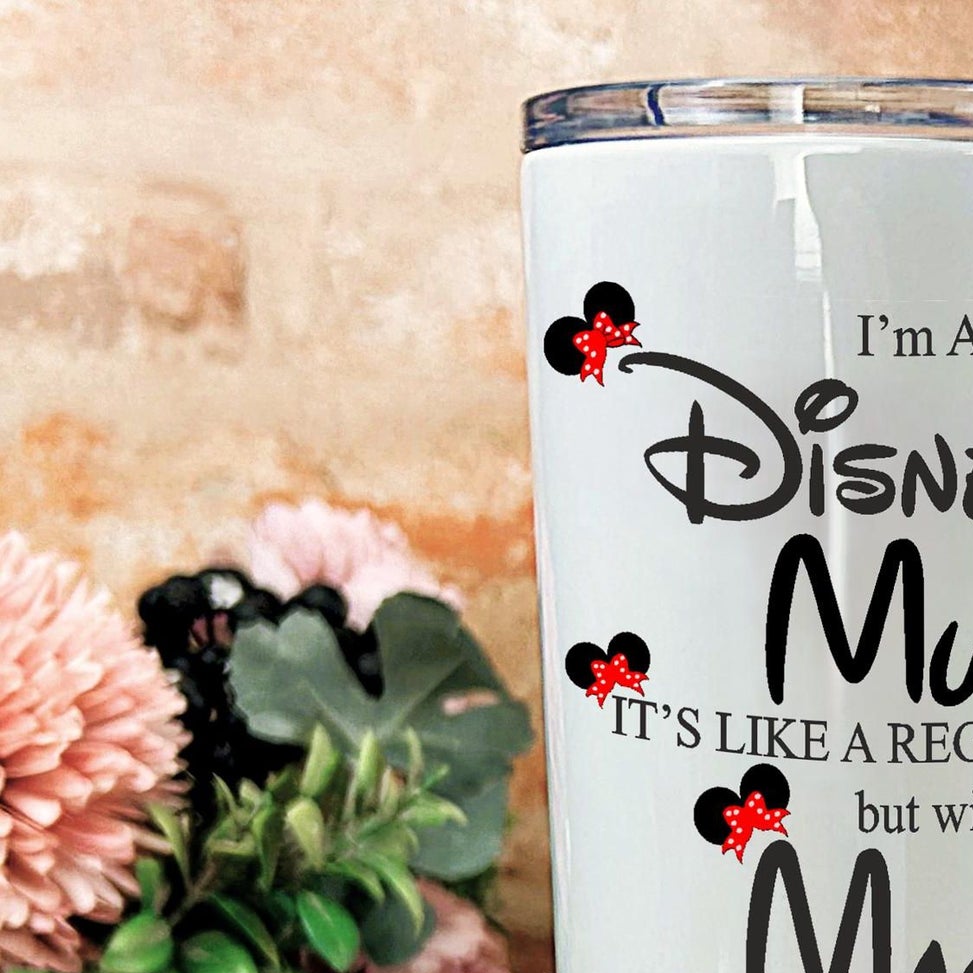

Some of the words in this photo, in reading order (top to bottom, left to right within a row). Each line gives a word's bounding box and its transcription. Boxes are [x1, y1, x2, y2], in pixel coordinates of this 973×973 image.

[857, 314, 937, 357] I’m
[611, 694, 702, 749] IT’S
[715, 711, 830, 763] LIKE
[840, 722, 877, 764] A
[854, 789, 920, 834] but
